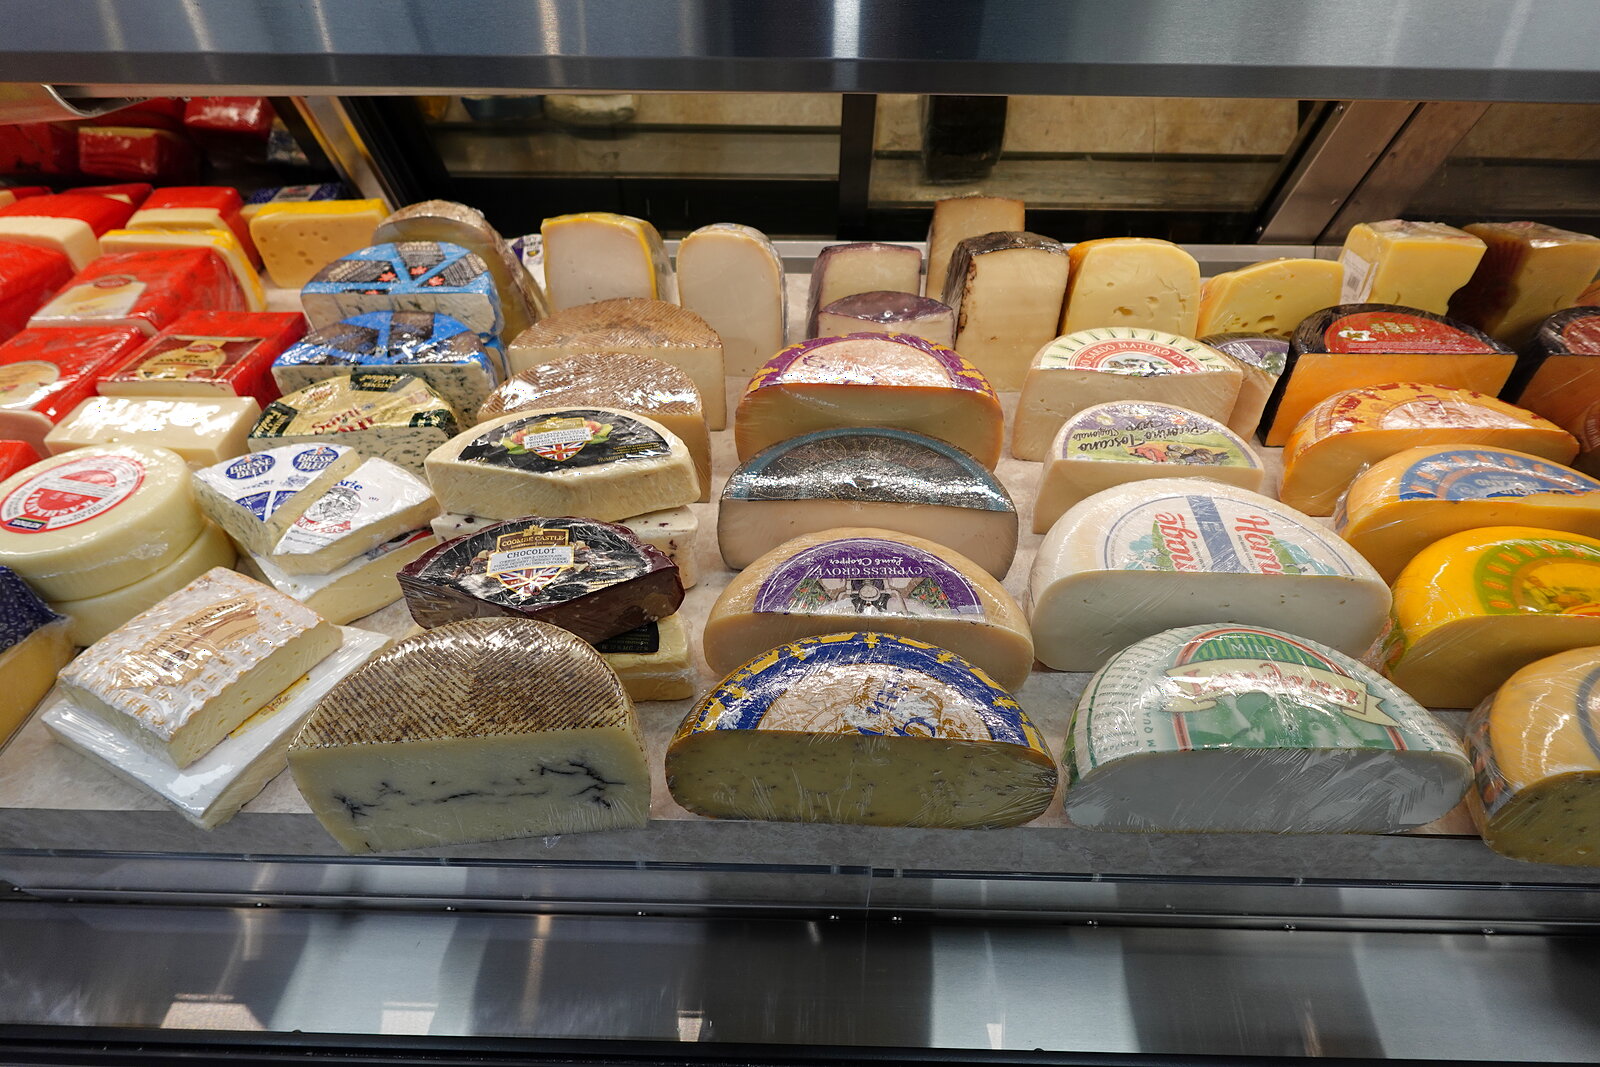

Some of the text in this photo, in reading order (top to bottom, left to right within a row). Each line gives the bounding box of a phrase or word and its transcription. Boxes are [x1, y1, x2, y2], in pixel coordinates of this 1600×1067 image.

[1086, 344, 1117, 362] SARDO
[1118, 342, 1171, 356] MATURO
[1078, 422, 1210, 452] Pecorino Toscano
[298, 453, 336, 463] BRESSE
[230, 458, 274, 475] BRESSE
[236, 466, 269, 480] BLEU
[501, 536, 534, 547] COOMBE
[534, 534, 567, 542] CASTLE
[506, 547, 557, 559] CHOCOLOT
[829, 556, 904, 566] Lamb Chopper
[863, 566, 924, 577] CYPRESS
[1230, 642, 1279, 656] MILD
